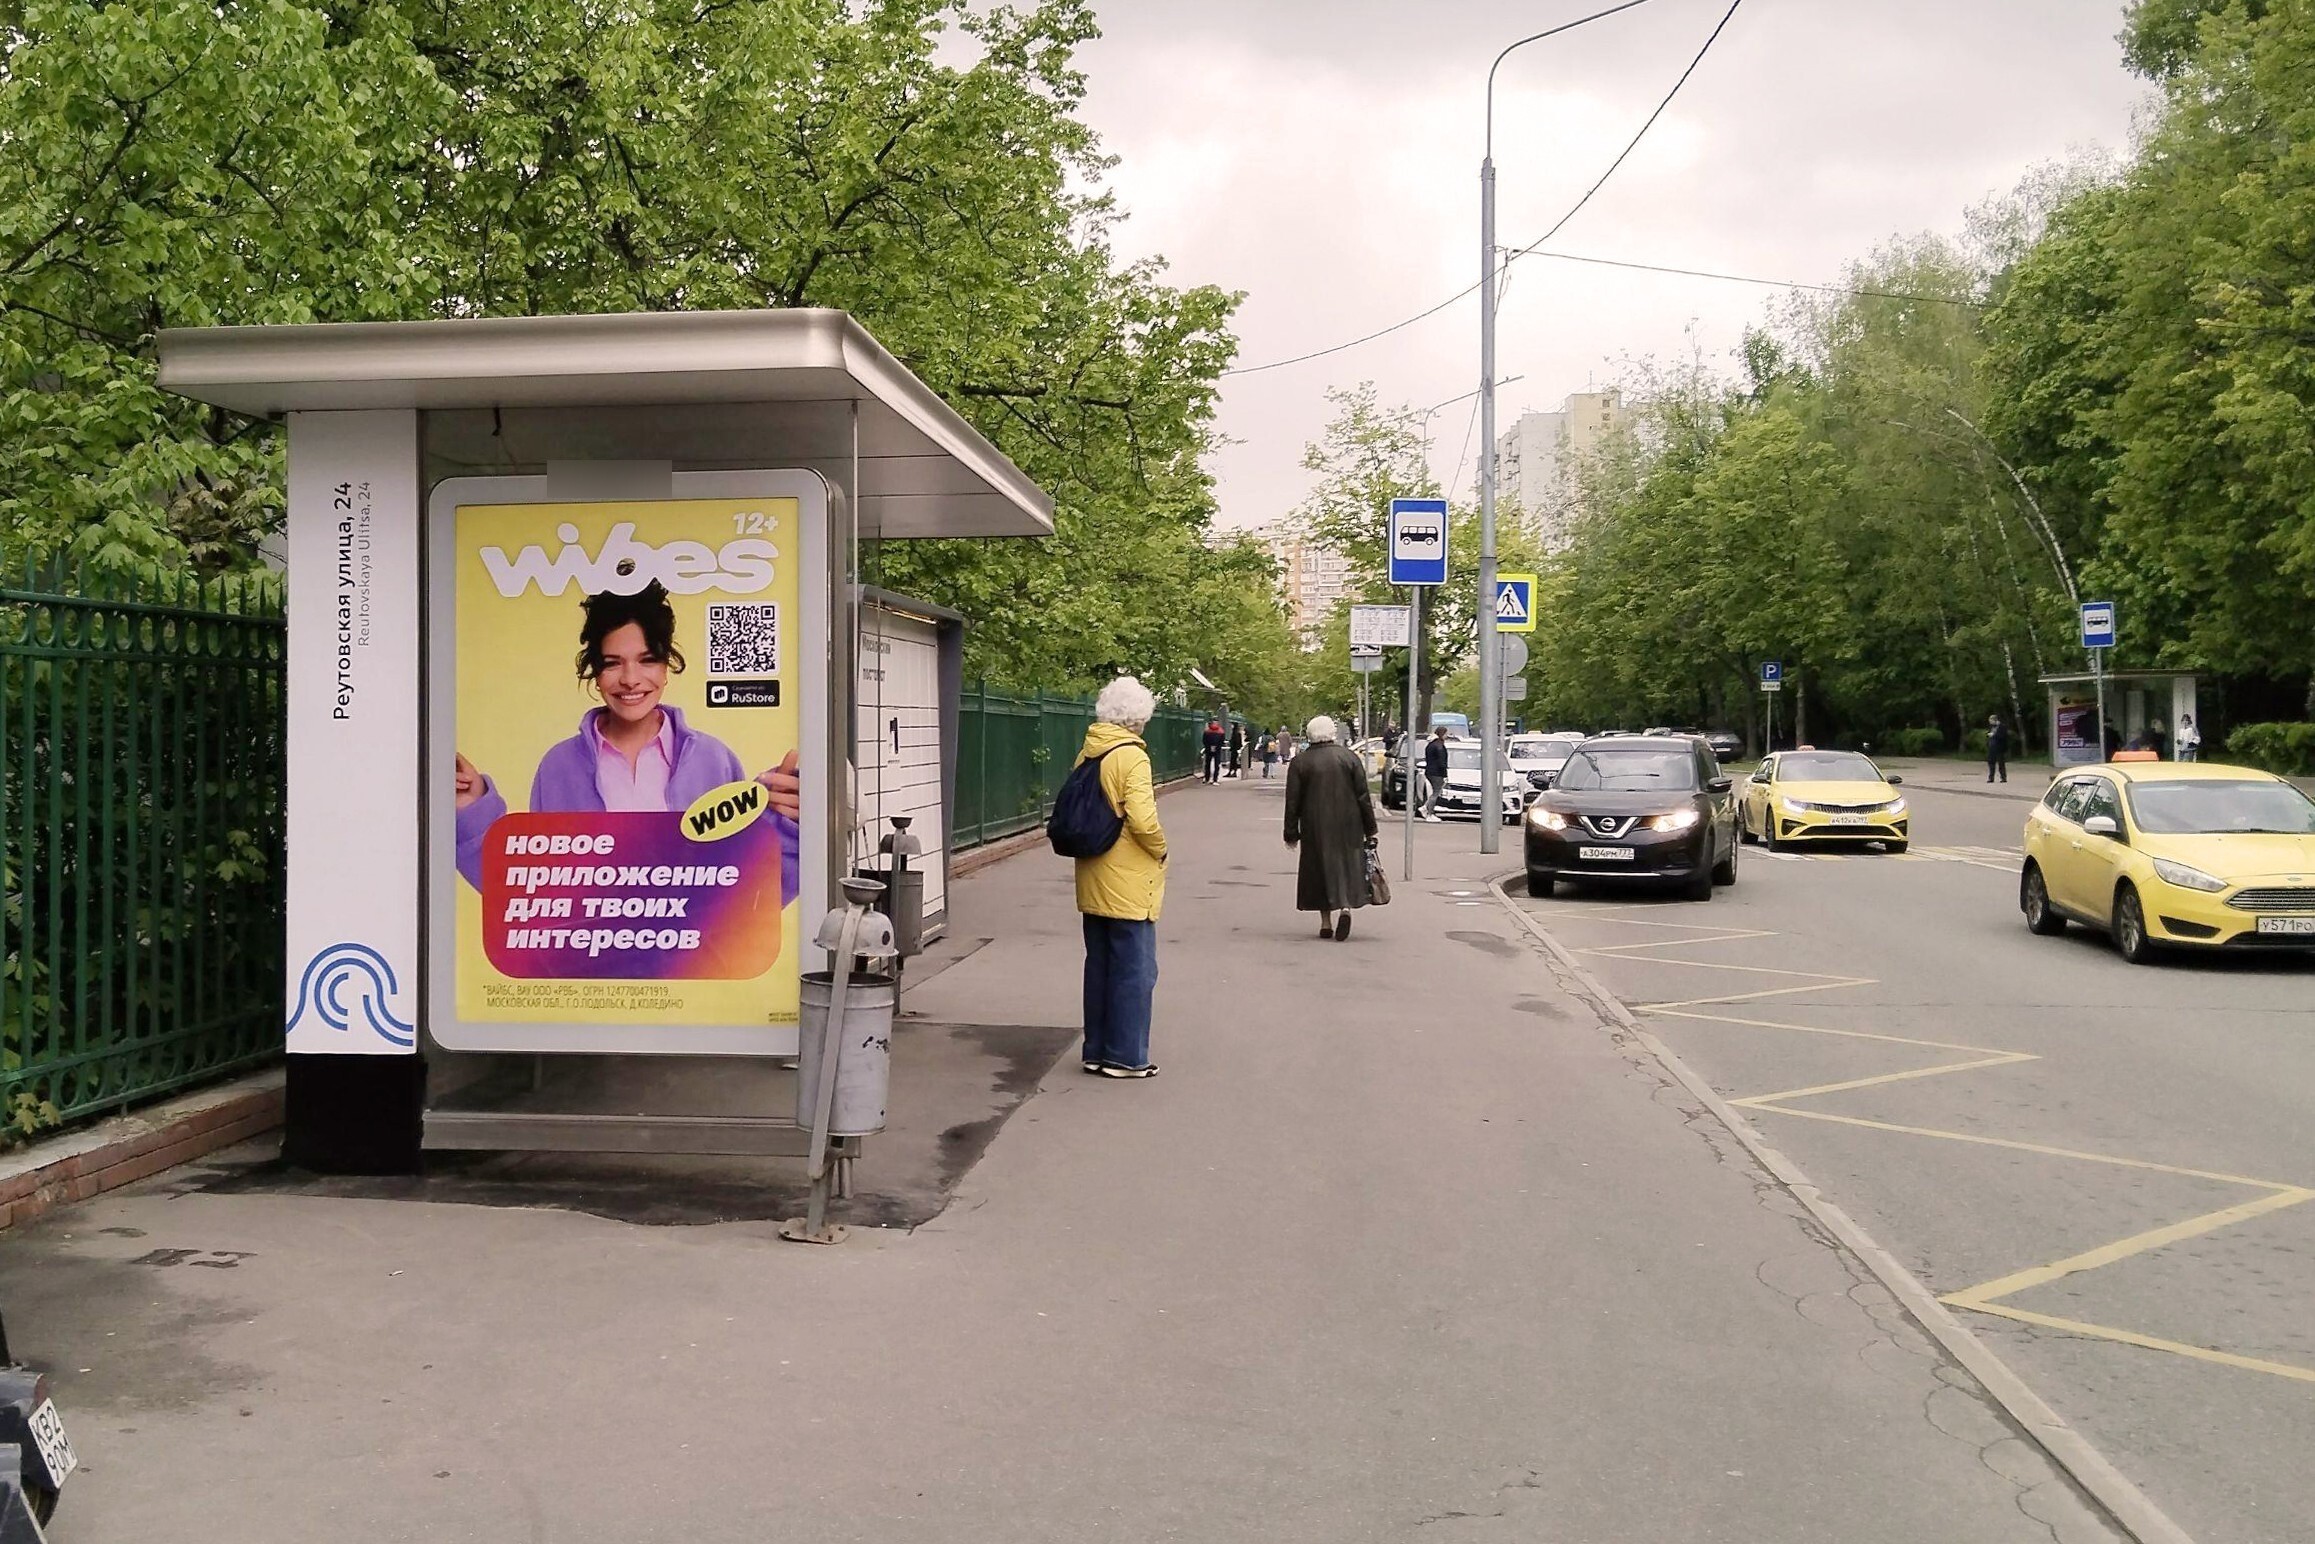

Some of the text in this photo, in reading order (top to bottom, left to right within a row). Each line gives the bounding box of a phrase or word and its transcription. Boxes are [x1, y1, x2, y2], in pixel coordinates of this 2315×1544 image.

[732, 512, 779, 536] 12+
[358, 481, 373, 647] Reutovskaya Ulitsa, 24
[479, 522, 779, 598] wibes
[333, 481, 355, 720] Реутовская улица, 24
[731, 692, 775, 704] RuStore
[688, 785, 759, 837] WOW
[504, 834, 616, 856] новое
[505, 864, 740, 894] приложение
[504, 897, 690, 923] для твоих
[505, 928, 702, 958] интересов
[487, 997, 541, 1009] МОСКОВСКАЯ
[533, 985, 551, 996] ООО
[583, 985, 604, 996] ОГРН
